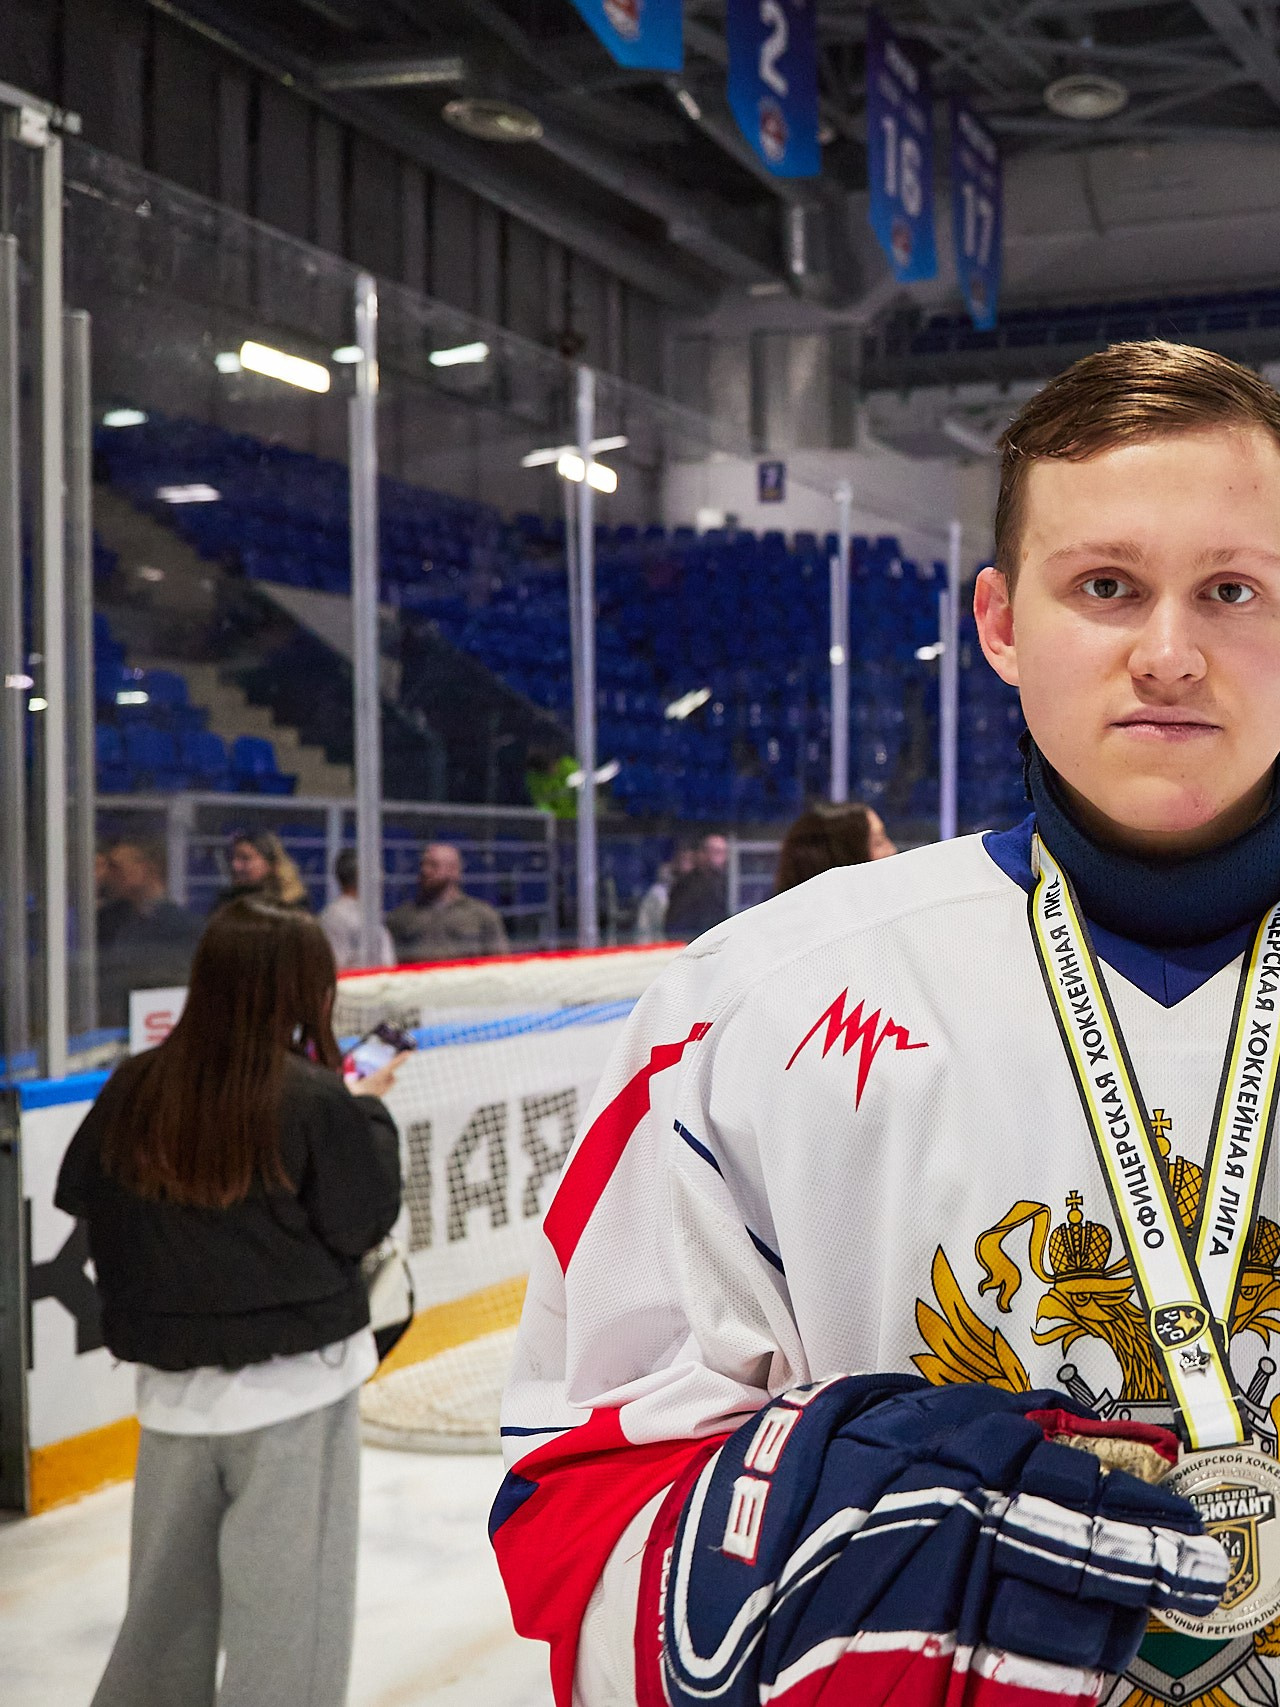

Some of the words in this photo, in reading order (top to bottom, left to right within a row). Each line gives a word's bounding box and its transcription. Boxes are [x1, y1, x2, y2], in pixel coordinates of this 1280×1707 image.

[1043, 874, 1064, 919] ЛИГА
[1050, 925, 1109, 1067] ХОККЕЙНАЯ
[1223, 1019, 1272, 1178] ХОККЕЙНАЯ
[1095, 1072, 1165, 1251] ОФИЦЕРСКАЯ
[1208, 1184, 1242, 1257] ЛИГА
[1167, 1453, 1243, 1487] ОФИЦЕРСКОЙ
[1197, 1495, 1272, 1522] БЮТАНТ
[1162, 1608, 1204, 1633] ОЧНЫЙ
